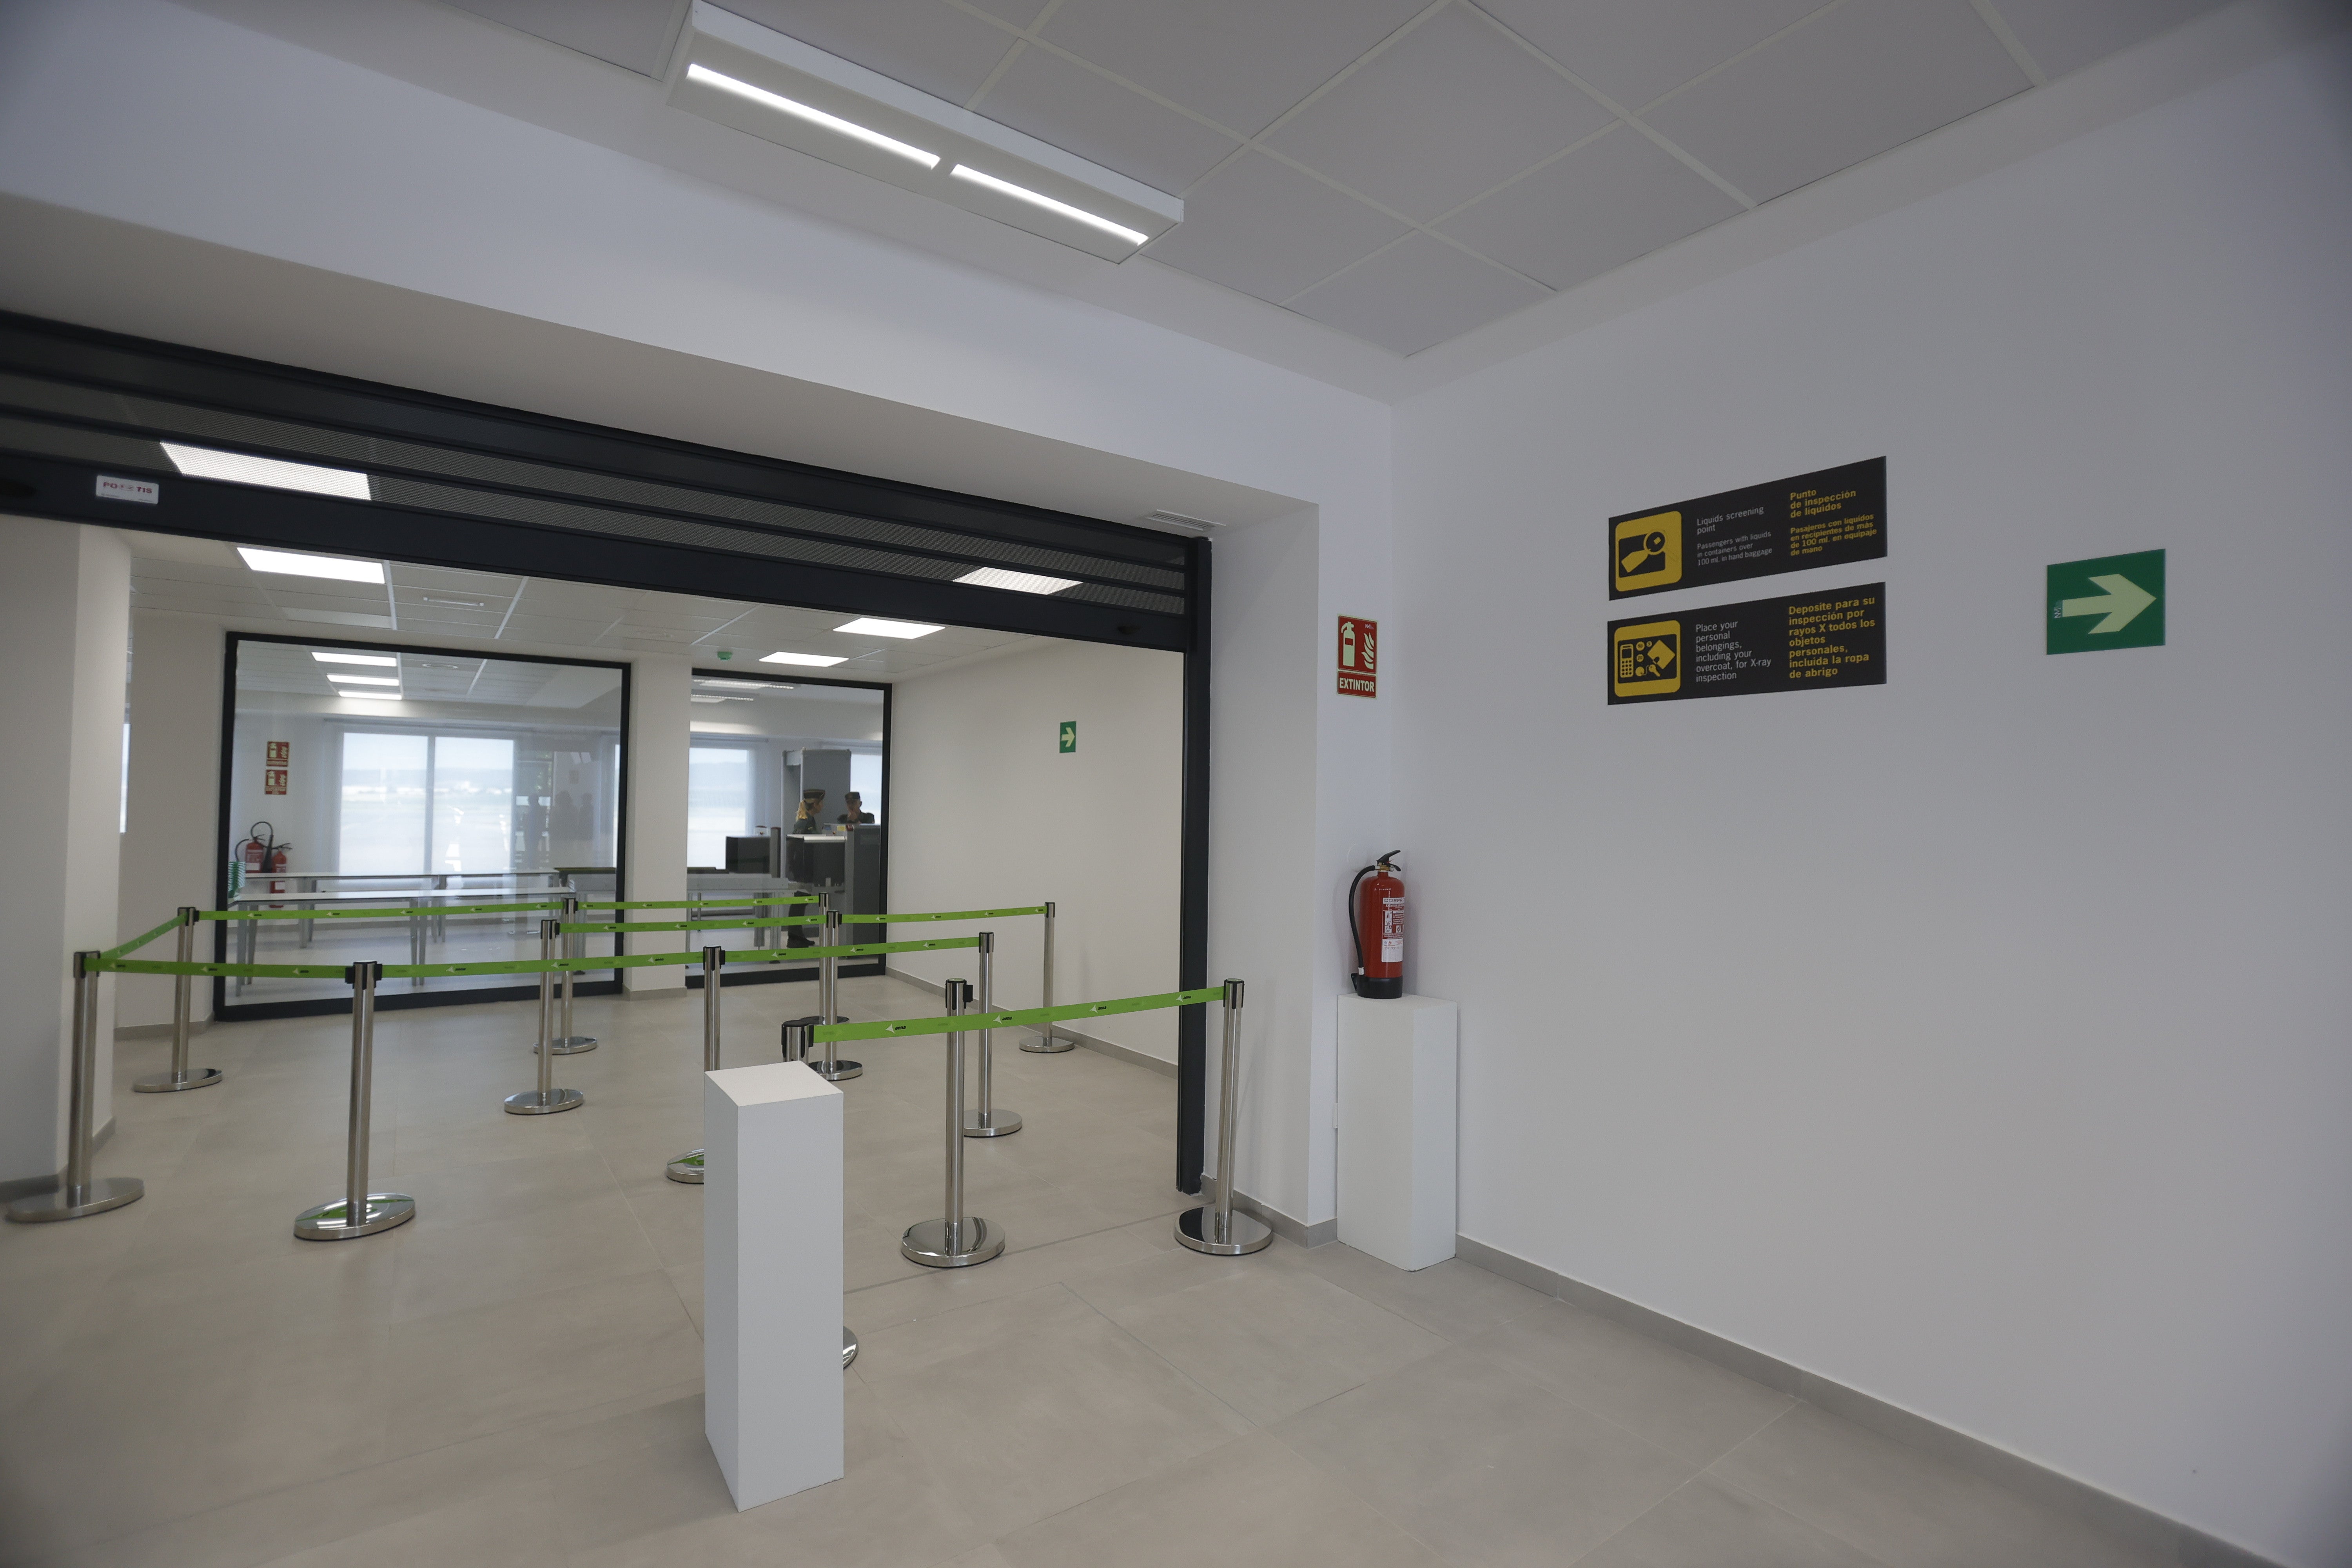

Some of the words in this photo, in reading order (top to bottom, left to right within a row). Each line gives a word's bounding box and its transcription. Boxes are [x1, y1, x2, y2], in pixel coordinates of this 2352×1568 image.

[1790, 490, 1817, 500] Punto
[1805, 490, 1856, 506] inspección
[1697, 514, 1724, 526] Liquids
[1726, 507, 1764, 520] screening
[1697, 524, 1716, 535] point
[1790, 523, 1826, 534] Pasajeros
[1802, 528, 1843, 539] recipientes
[1697, 539, 1733, 549] Passengers
[1750, 531, 1771, 540] liquids
[1803, 538, 1817, 546] 100
[1844, 528, 1877, 539] equipaje
[1705, 546, 1737, 557] containers
[1745, 548, 1773, 557] baggage
[1789, 602, 1832, 615] Deposite
[1835, 599, 1859, 610] para
[1789, 612, 1843, 625] inspección
[1847, 609, 1865, 620] por
[1696, 624, 1717, 632] Place
[1720, 621, 1739, 631] your
[1789, 627, 1816, 637] rayos
[1818, 623, 1826, 632] X
[1829, 621, 1857, 632] todos
[1860, 619, 1875, 628] los
[1696, 630, 1730, 643] personal
[1789, 636, 1826, 647] objetos
[1696, 641, 1742, 652] belongings,
[1789, 645, 1848, 659] personales,
[1696, 652, 1731, 662] including
[1734, 650, 1752, 660] your
[1789, 657, 1829, 668] incluida
[1831, 655, 1841, 664] la
[1845, 654, 1869, 663] ropa
[1696, 662, 1733, 672] overcoat,
[1736, 660, 1748, 669] for
[1750, 659, 1772, 668] X-ray
[1696, 671, 1737, 683] inspection
[1789, 670, 1802, 679] de
[1805, 667, 1838, 677] abrigo
[1339, 677, 1374, 693] EXTINTOR
